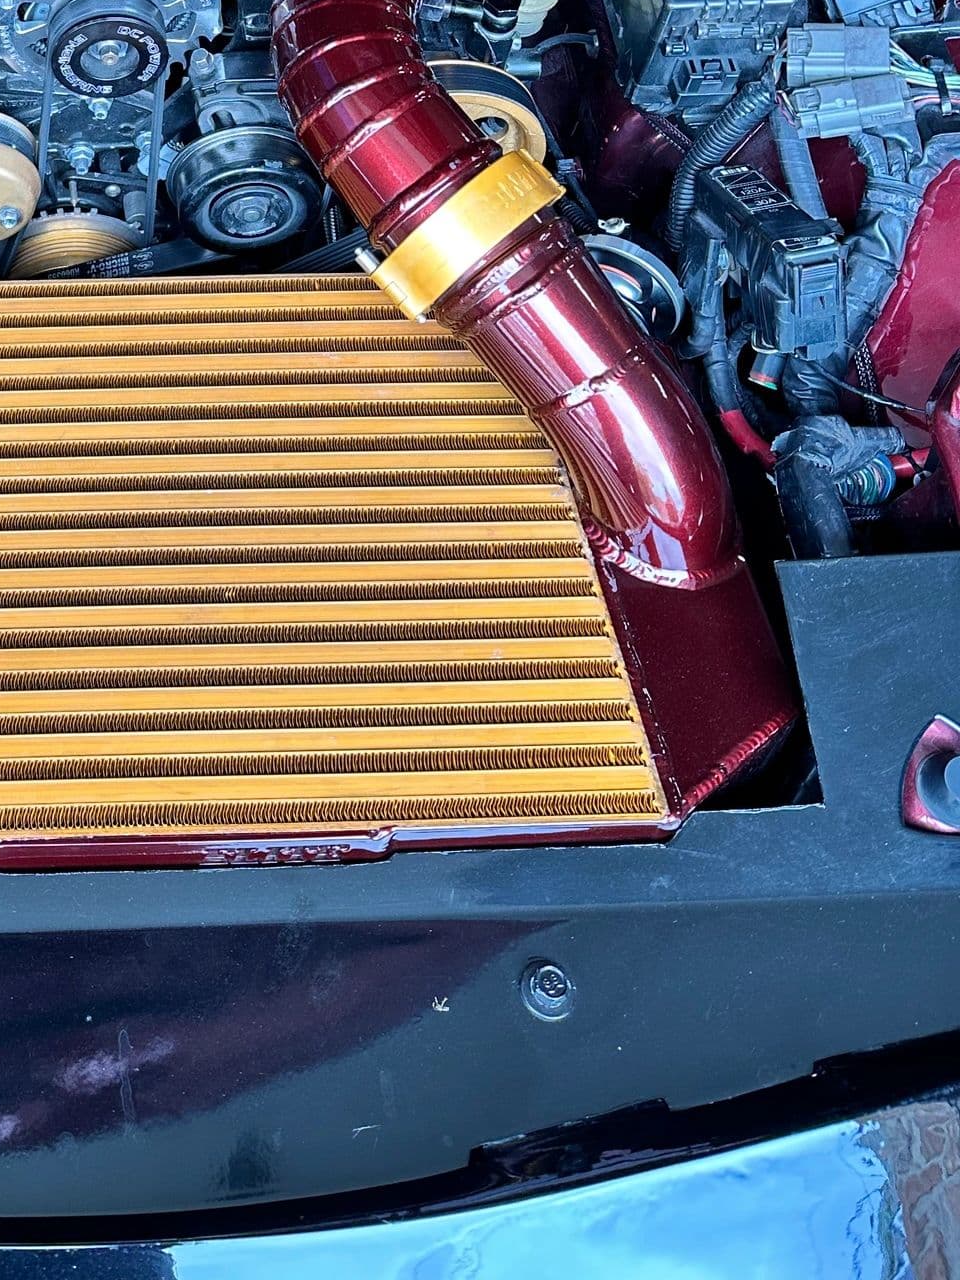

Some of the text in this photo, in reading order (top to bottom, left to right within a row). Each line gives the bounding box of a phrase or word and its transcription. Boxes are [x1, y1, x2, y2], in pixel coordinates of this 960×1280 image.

[58, 33, 114, 94] ENGINEERING
[117, 25, 161, 82] DC POWER
[740, 187, 767, 195] 120A
[754, 198, 777, 206] 30A
